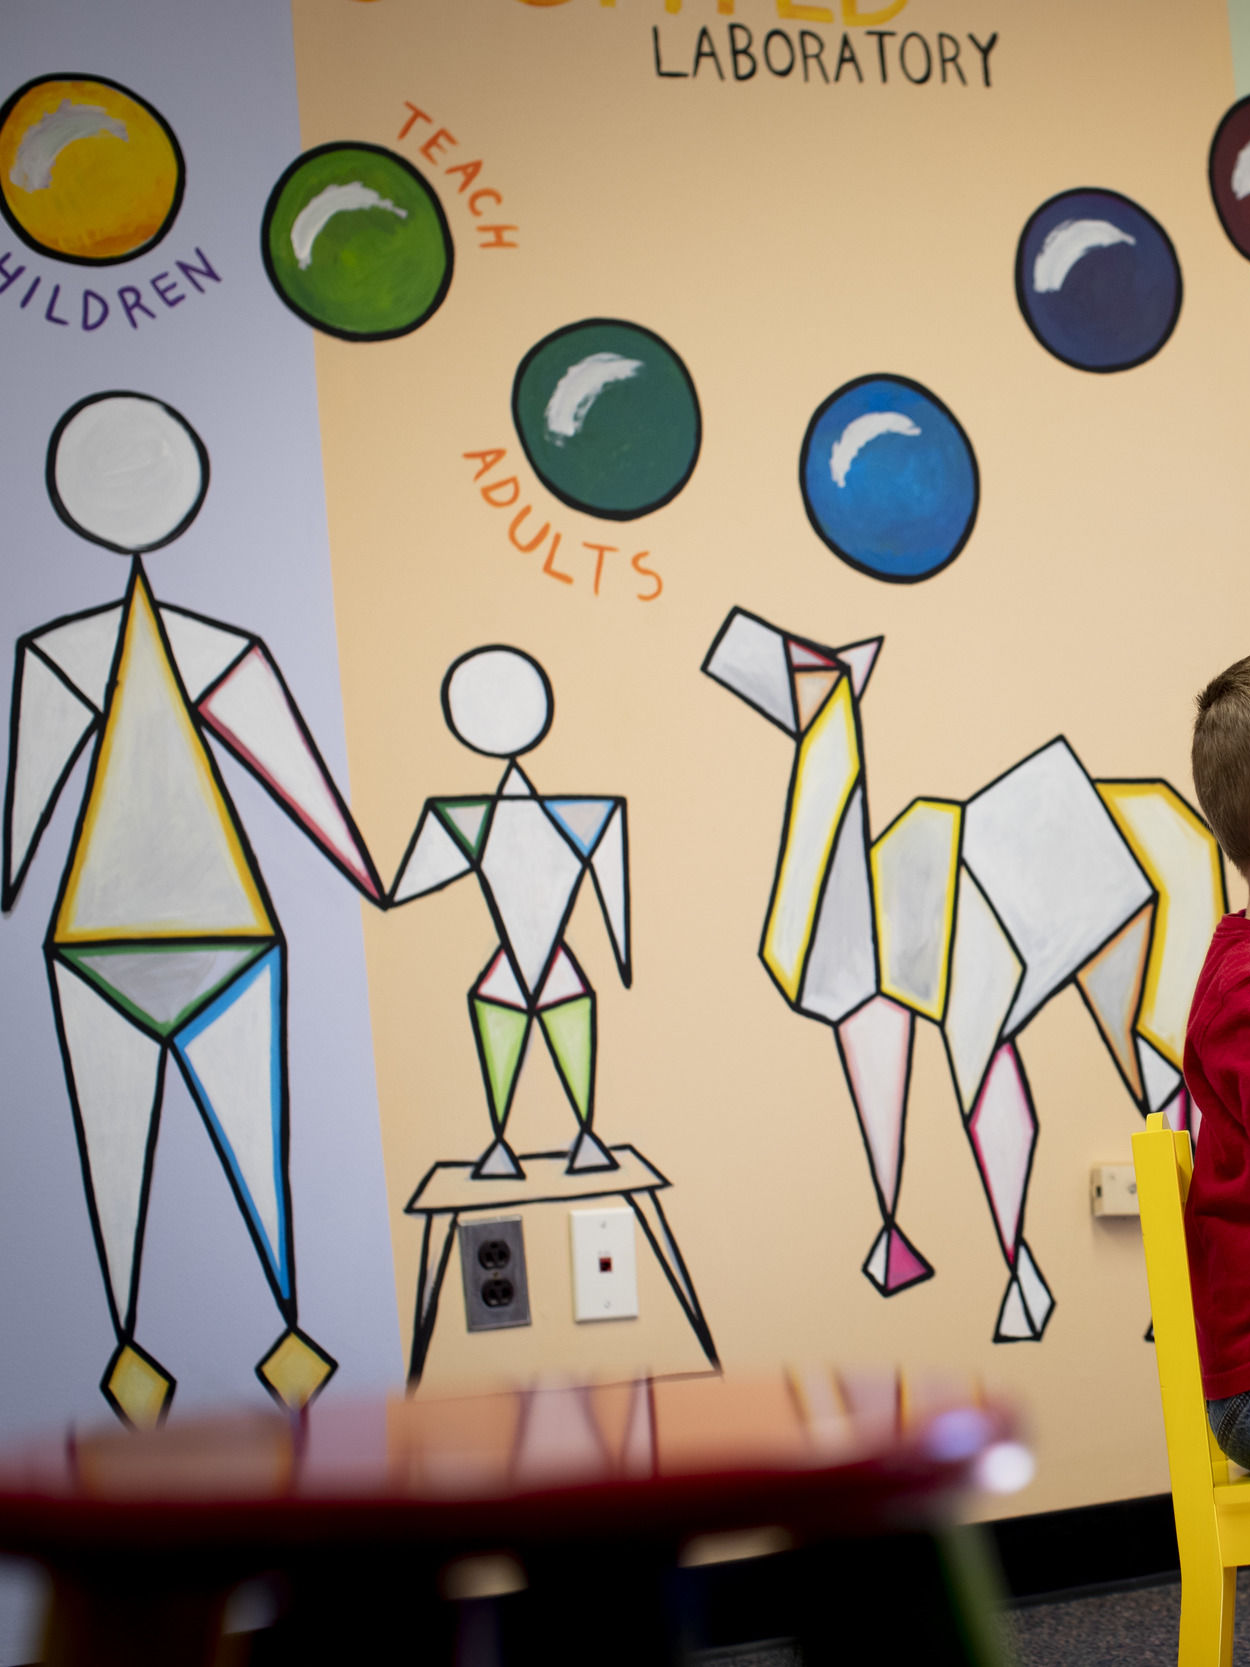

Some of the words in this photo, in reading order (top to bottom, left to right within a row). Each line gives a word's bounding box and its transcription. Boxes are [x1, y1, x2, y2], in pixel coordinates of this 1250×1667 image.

[652, 23, 999, 88] LABORATORY
[397, 101, 519, 249] TEACH
[461, 447, 664, 603] ADULTS
